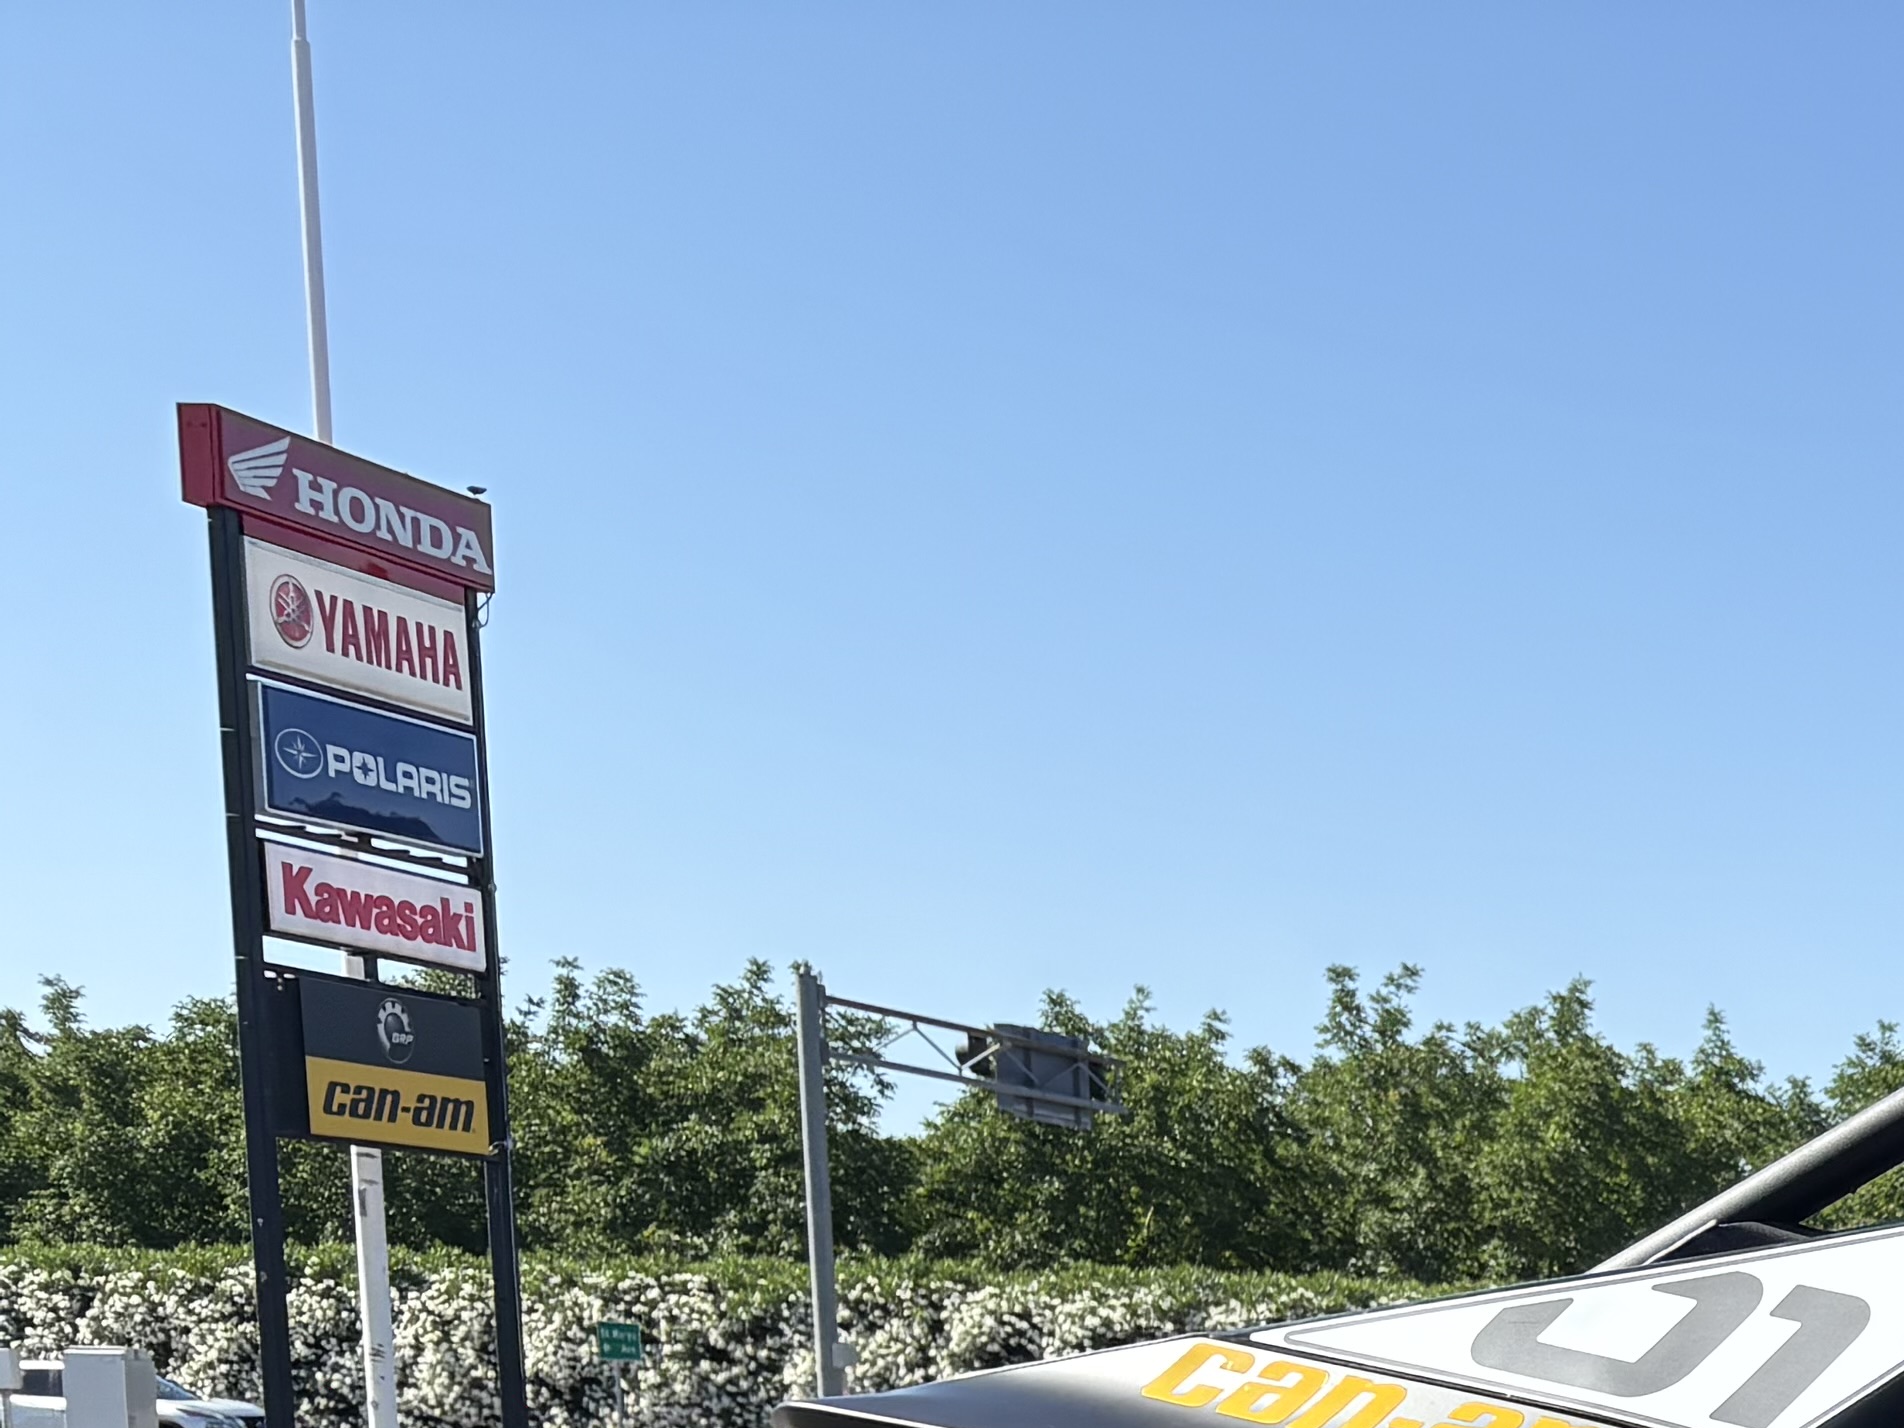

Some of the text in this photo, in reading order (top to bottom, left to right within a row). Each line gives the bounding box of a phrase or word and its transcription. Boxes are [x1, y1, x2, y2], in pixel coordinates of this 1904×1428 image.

[292, 468, 492, 575] HONDA
[315, 589, 462, 691] YAMAHA
[326, 743, 472, 810] POLARIS
[281, 861, 476, 952] Kawasaki
[323, 1080, 474, 1133] can-am
